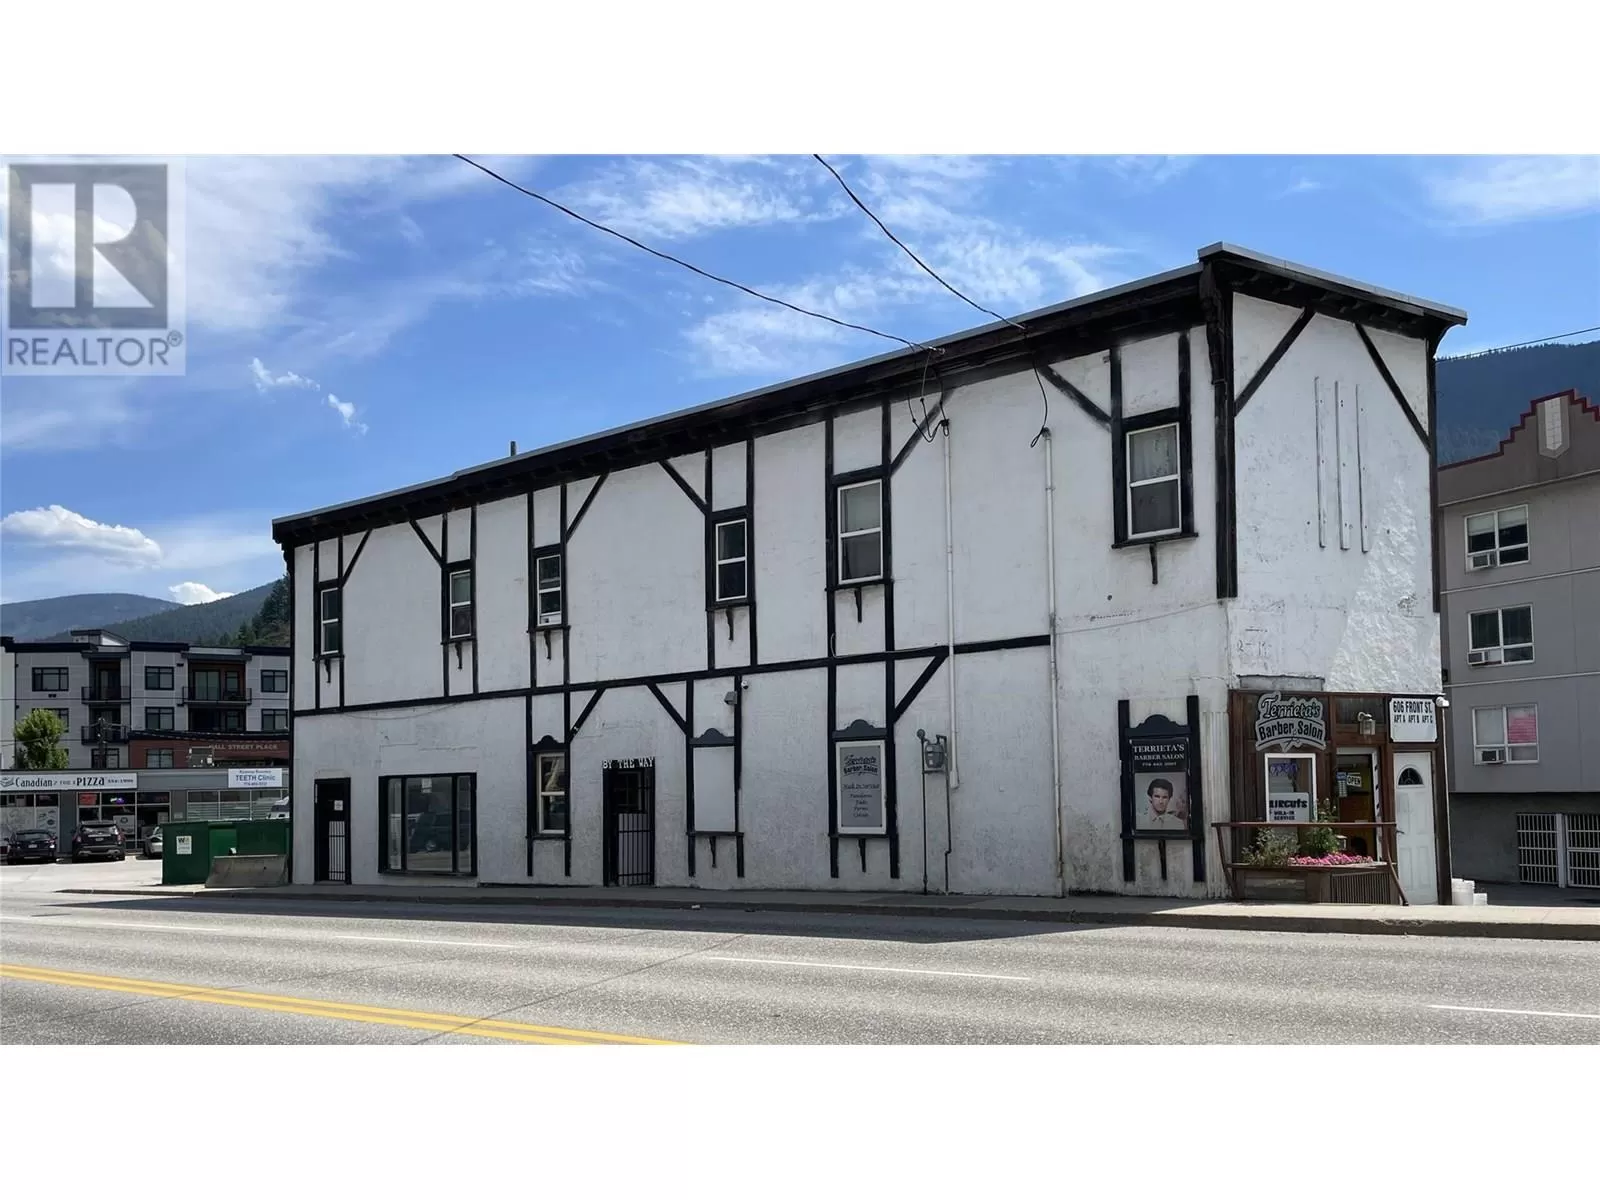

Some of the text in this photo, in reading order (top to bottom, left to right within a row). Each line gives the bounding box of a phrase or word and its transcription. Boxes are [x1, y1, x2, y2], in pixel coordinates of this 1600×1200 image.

[1261, 694, 1320, 718] Terrieta's
[1393, 700, 1404, 713] 606
[1405, 701, 1423, 713] FRONT
[1393, 714, 1401, 723] APT
[1408, 714, 1416, 723] APT
[1259, 720, 1323, 740] Barber Salon
[1132, 744, 1185, 753] TERRIETA'S
[603, 756, 654, 769] BY THE WAY
[15, 778, 53, 788] Canadian
